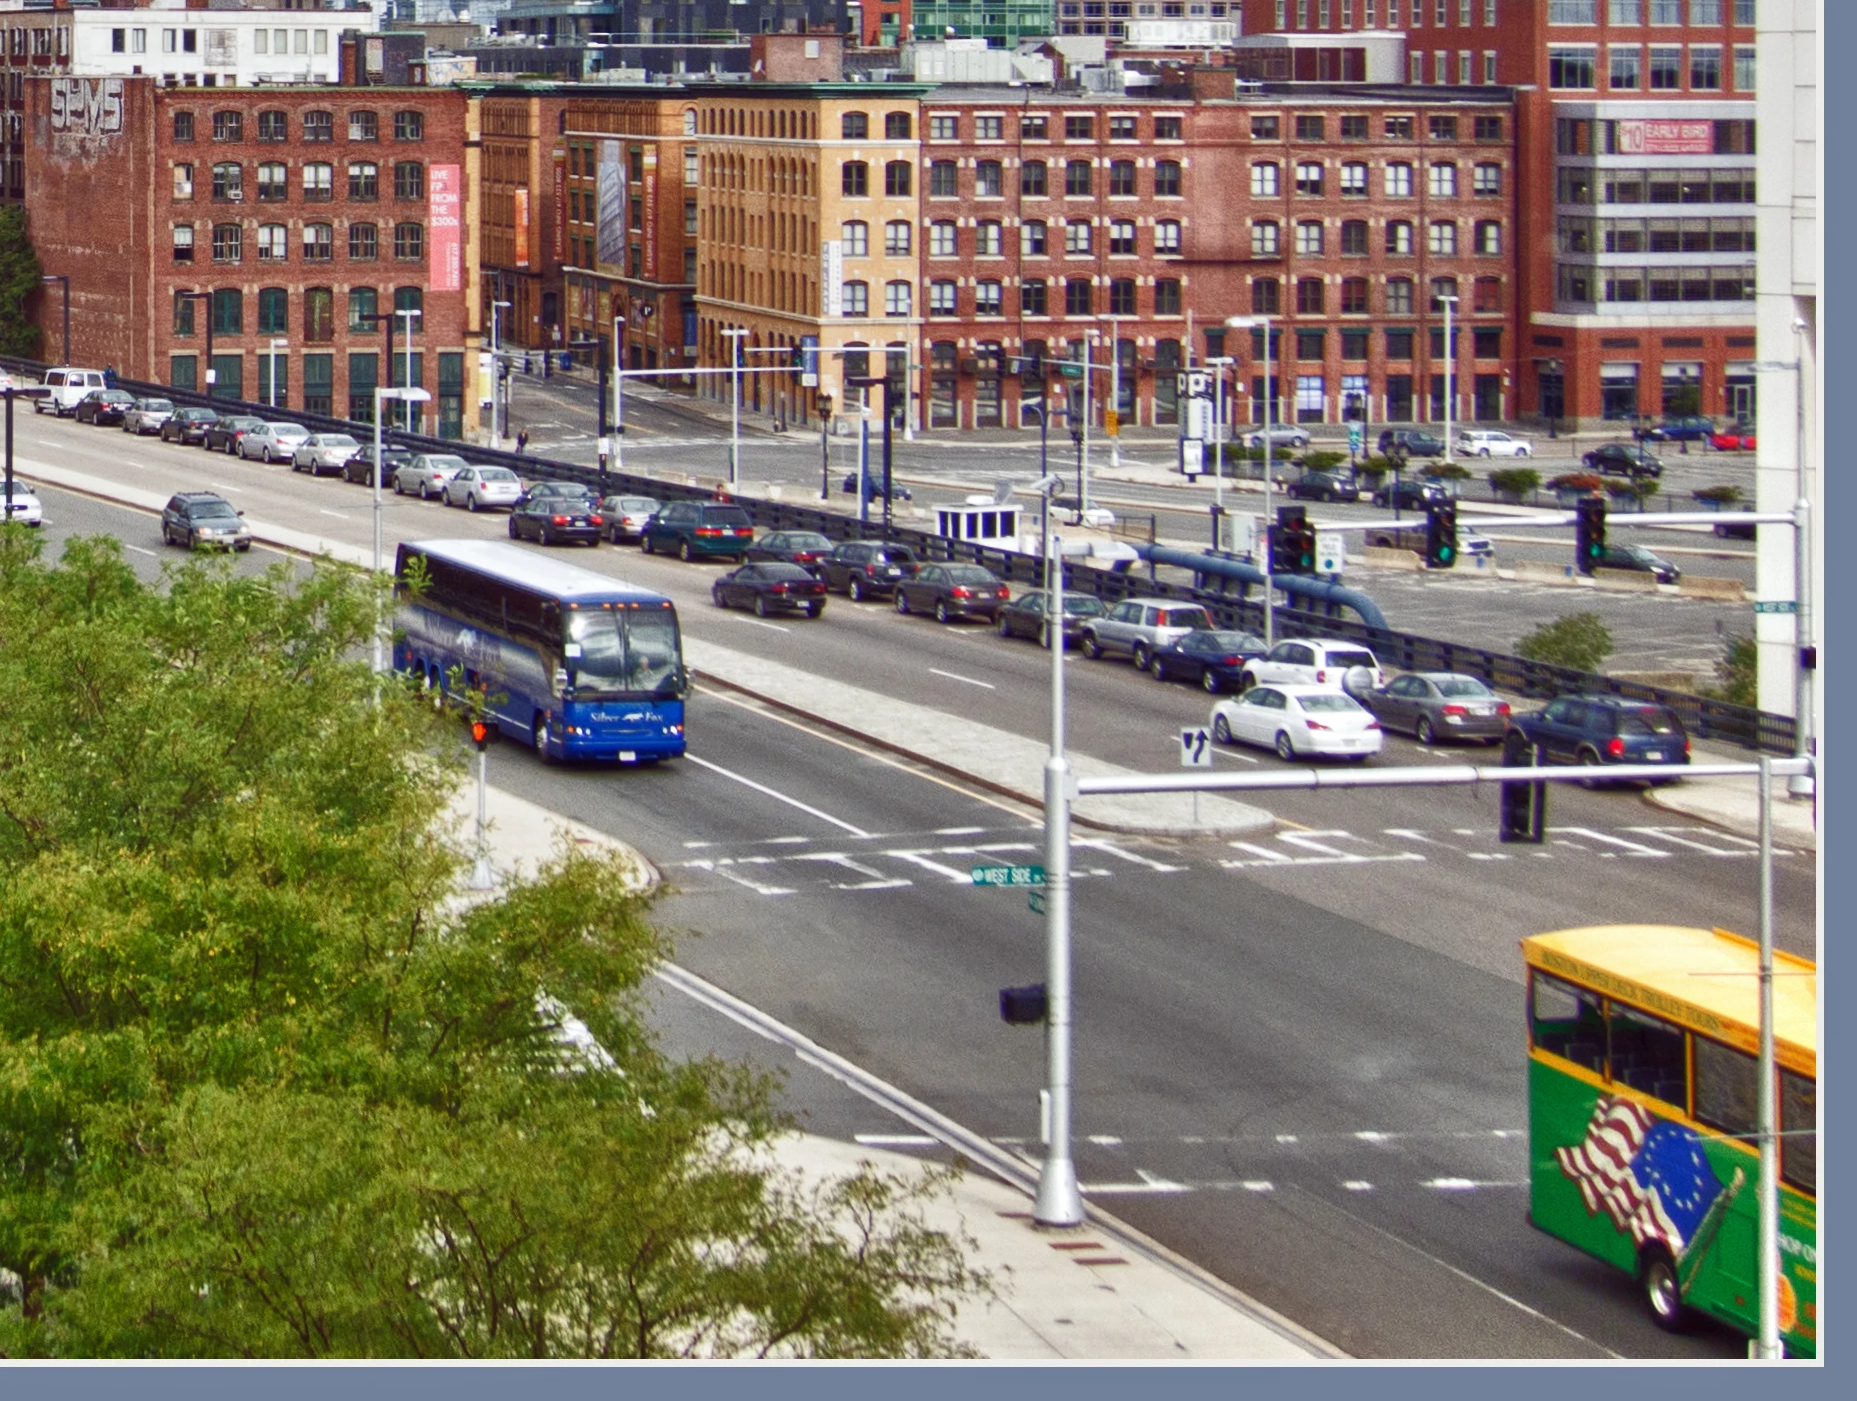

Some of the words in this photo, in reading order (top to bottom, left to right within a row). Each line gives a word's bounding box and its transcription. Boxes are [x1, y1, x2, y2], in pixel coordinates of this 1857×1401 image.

[1646, 124, 1680, 139] EARLY
[1683, 124, 1708, 138] BIRD
[431, 170, 447, 180] LIVE
[431, 193, 457, 203] FROM
[431, 205, 447, 214] THE
[591, 711, 619, 722] Silver
[646, 711, 663, 722] Fox
[984, 868, 1009, 883] WEST
[1011, 868, 1031, 883] SIDE
